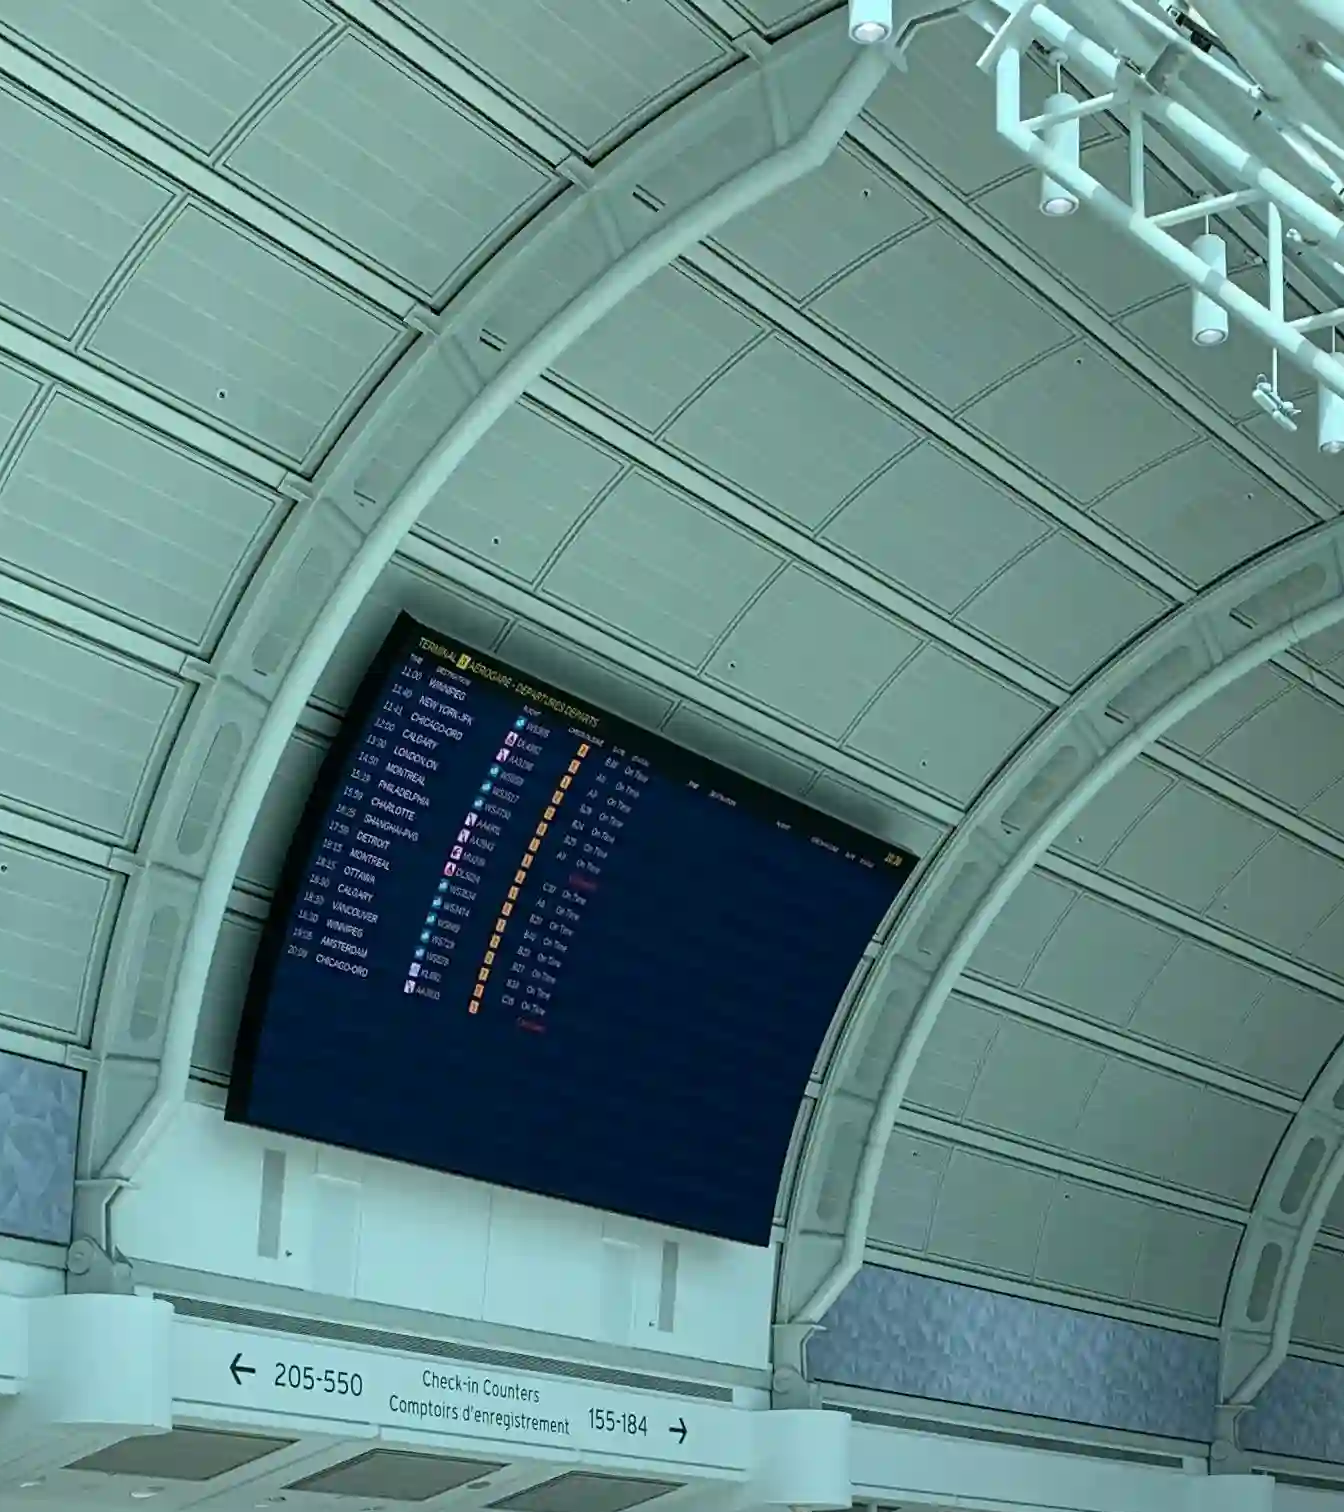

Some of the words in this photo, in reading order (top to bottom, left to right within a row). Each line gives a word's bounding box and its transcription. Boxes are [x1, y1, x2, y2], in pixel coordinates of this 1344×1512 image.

[402, 728, 440, 750] CALGARY
[385, 762, 426, 786] MONTREAL
[371, 797, 416, 822] CHARLOTTE
[357, 830, 391, 850] DETROIT
[349, 847, 391, 871] MONTREAL
[344, 865, 375, 885] OTTAWA
[337, 883, 374, 903] CALGARY
[332, 900, 379, 924] VANCOUVER
[326, 918, 364, 939] WINNIPEG
[320, 935, 368, 959] AMSTERDAM
[274, 1362, 363, 1398] 205-550
[422, 1370, 480, 1396] Check-in
[483, 1376, 540, 1403] Counters
[389, 1395, 458, 1422] Comptoirs
[462, 1403, 570, 1436] d'enregistrement
[588, 1408, 648, 1437] 155-184
